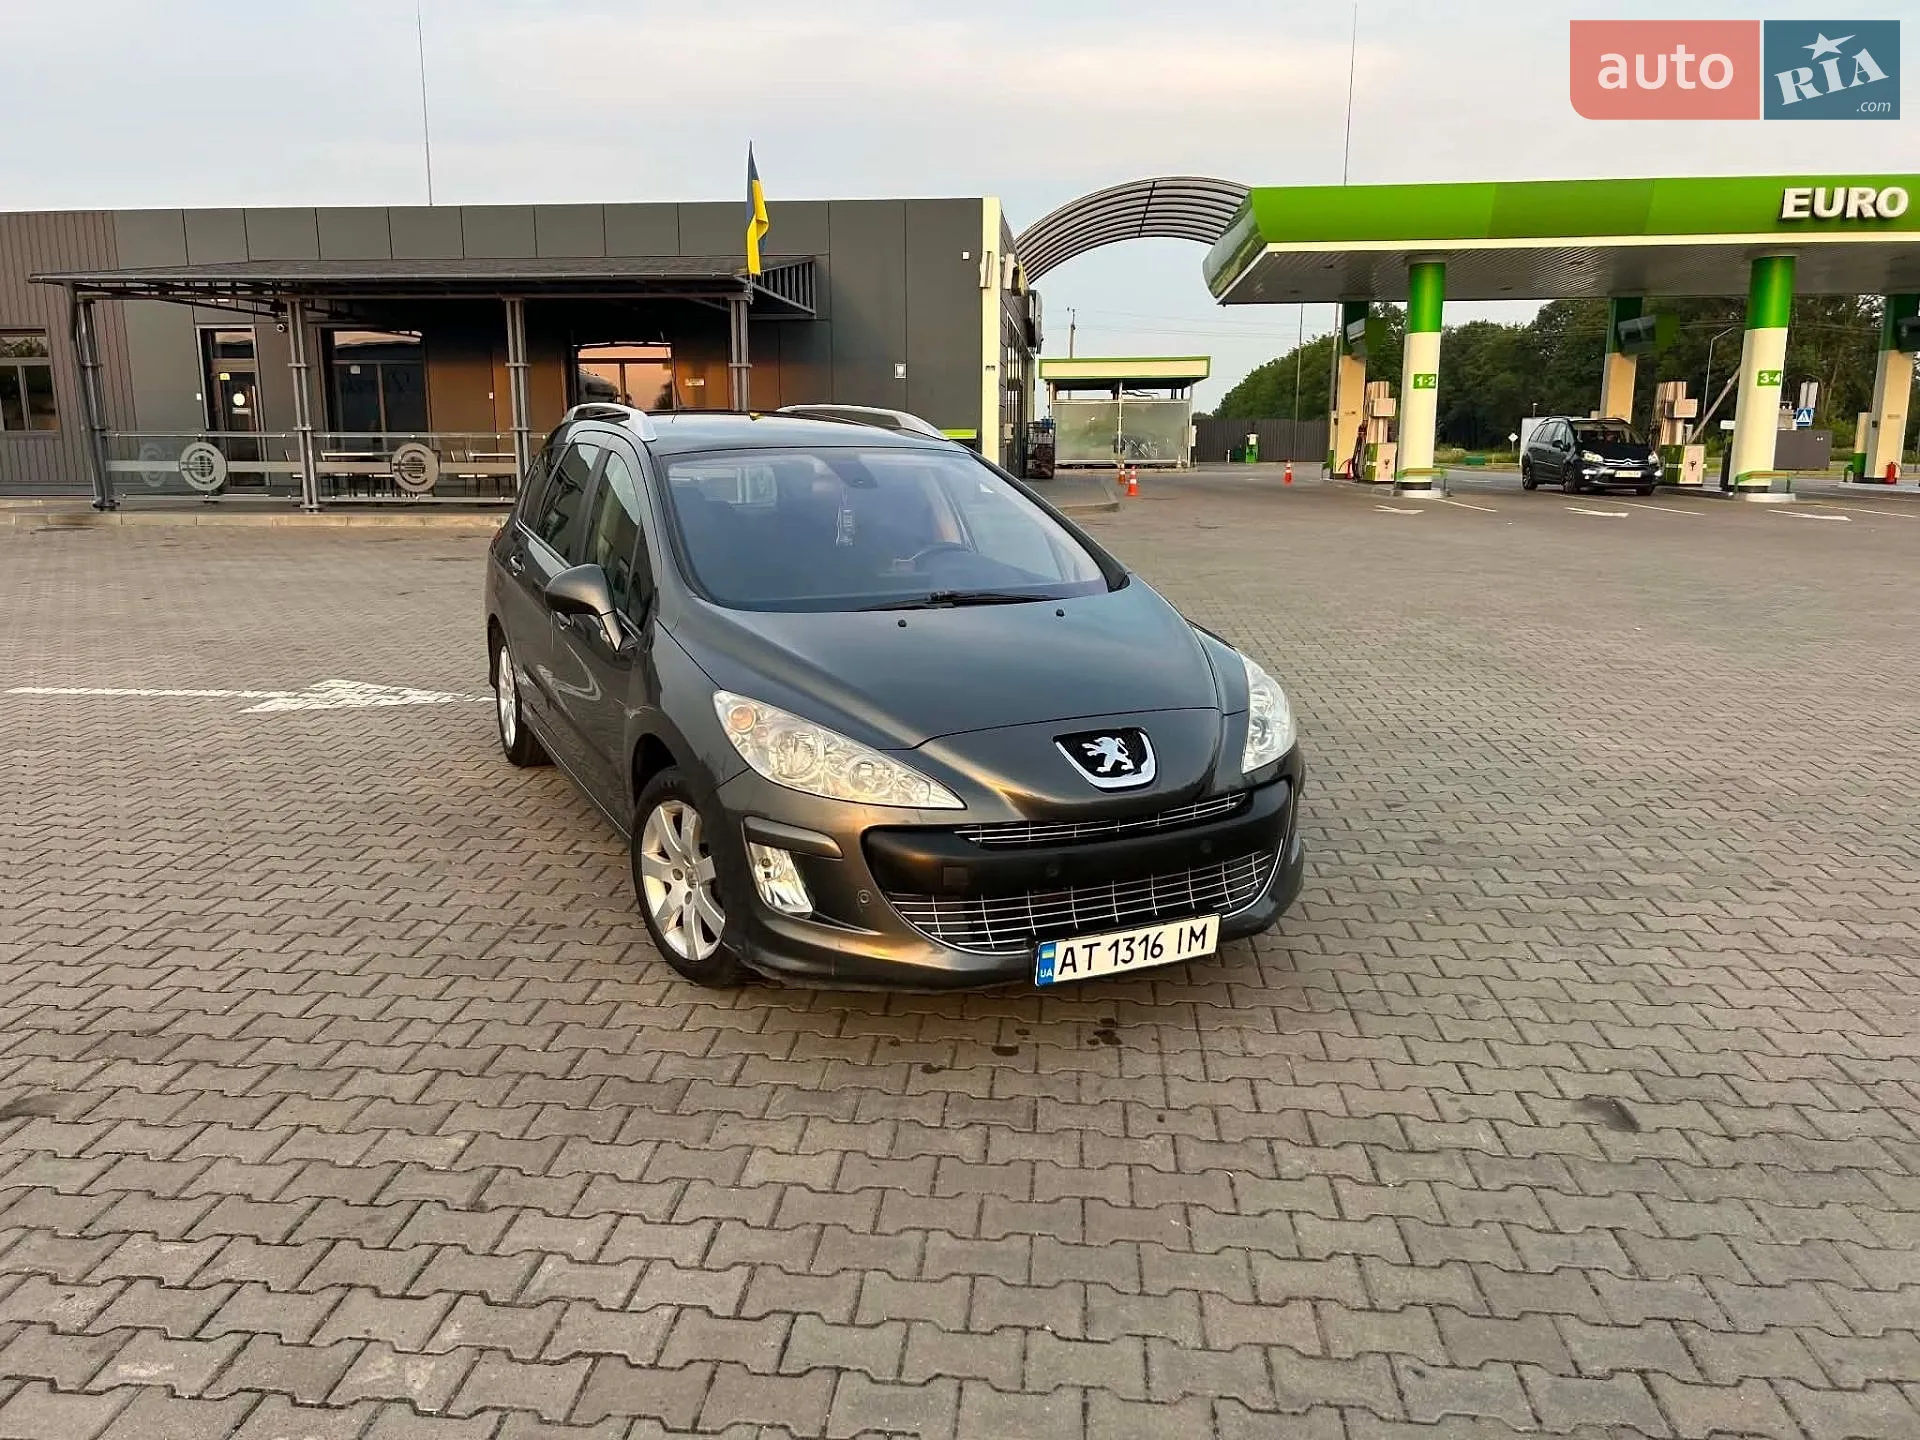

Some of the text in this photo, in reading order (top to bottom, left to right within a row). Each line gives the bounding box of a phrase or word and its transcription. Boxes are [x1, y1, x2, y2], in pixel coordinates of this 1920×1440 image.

[1781, 186, 1909, 219] EURO
[1416, 375, 1436, 387] 1-2
[1759, 372, 1781, 384] 3-4
[1058, 923, 1208, 975] AT 1316 IM
[1040, 968, 1053, 978] UA
